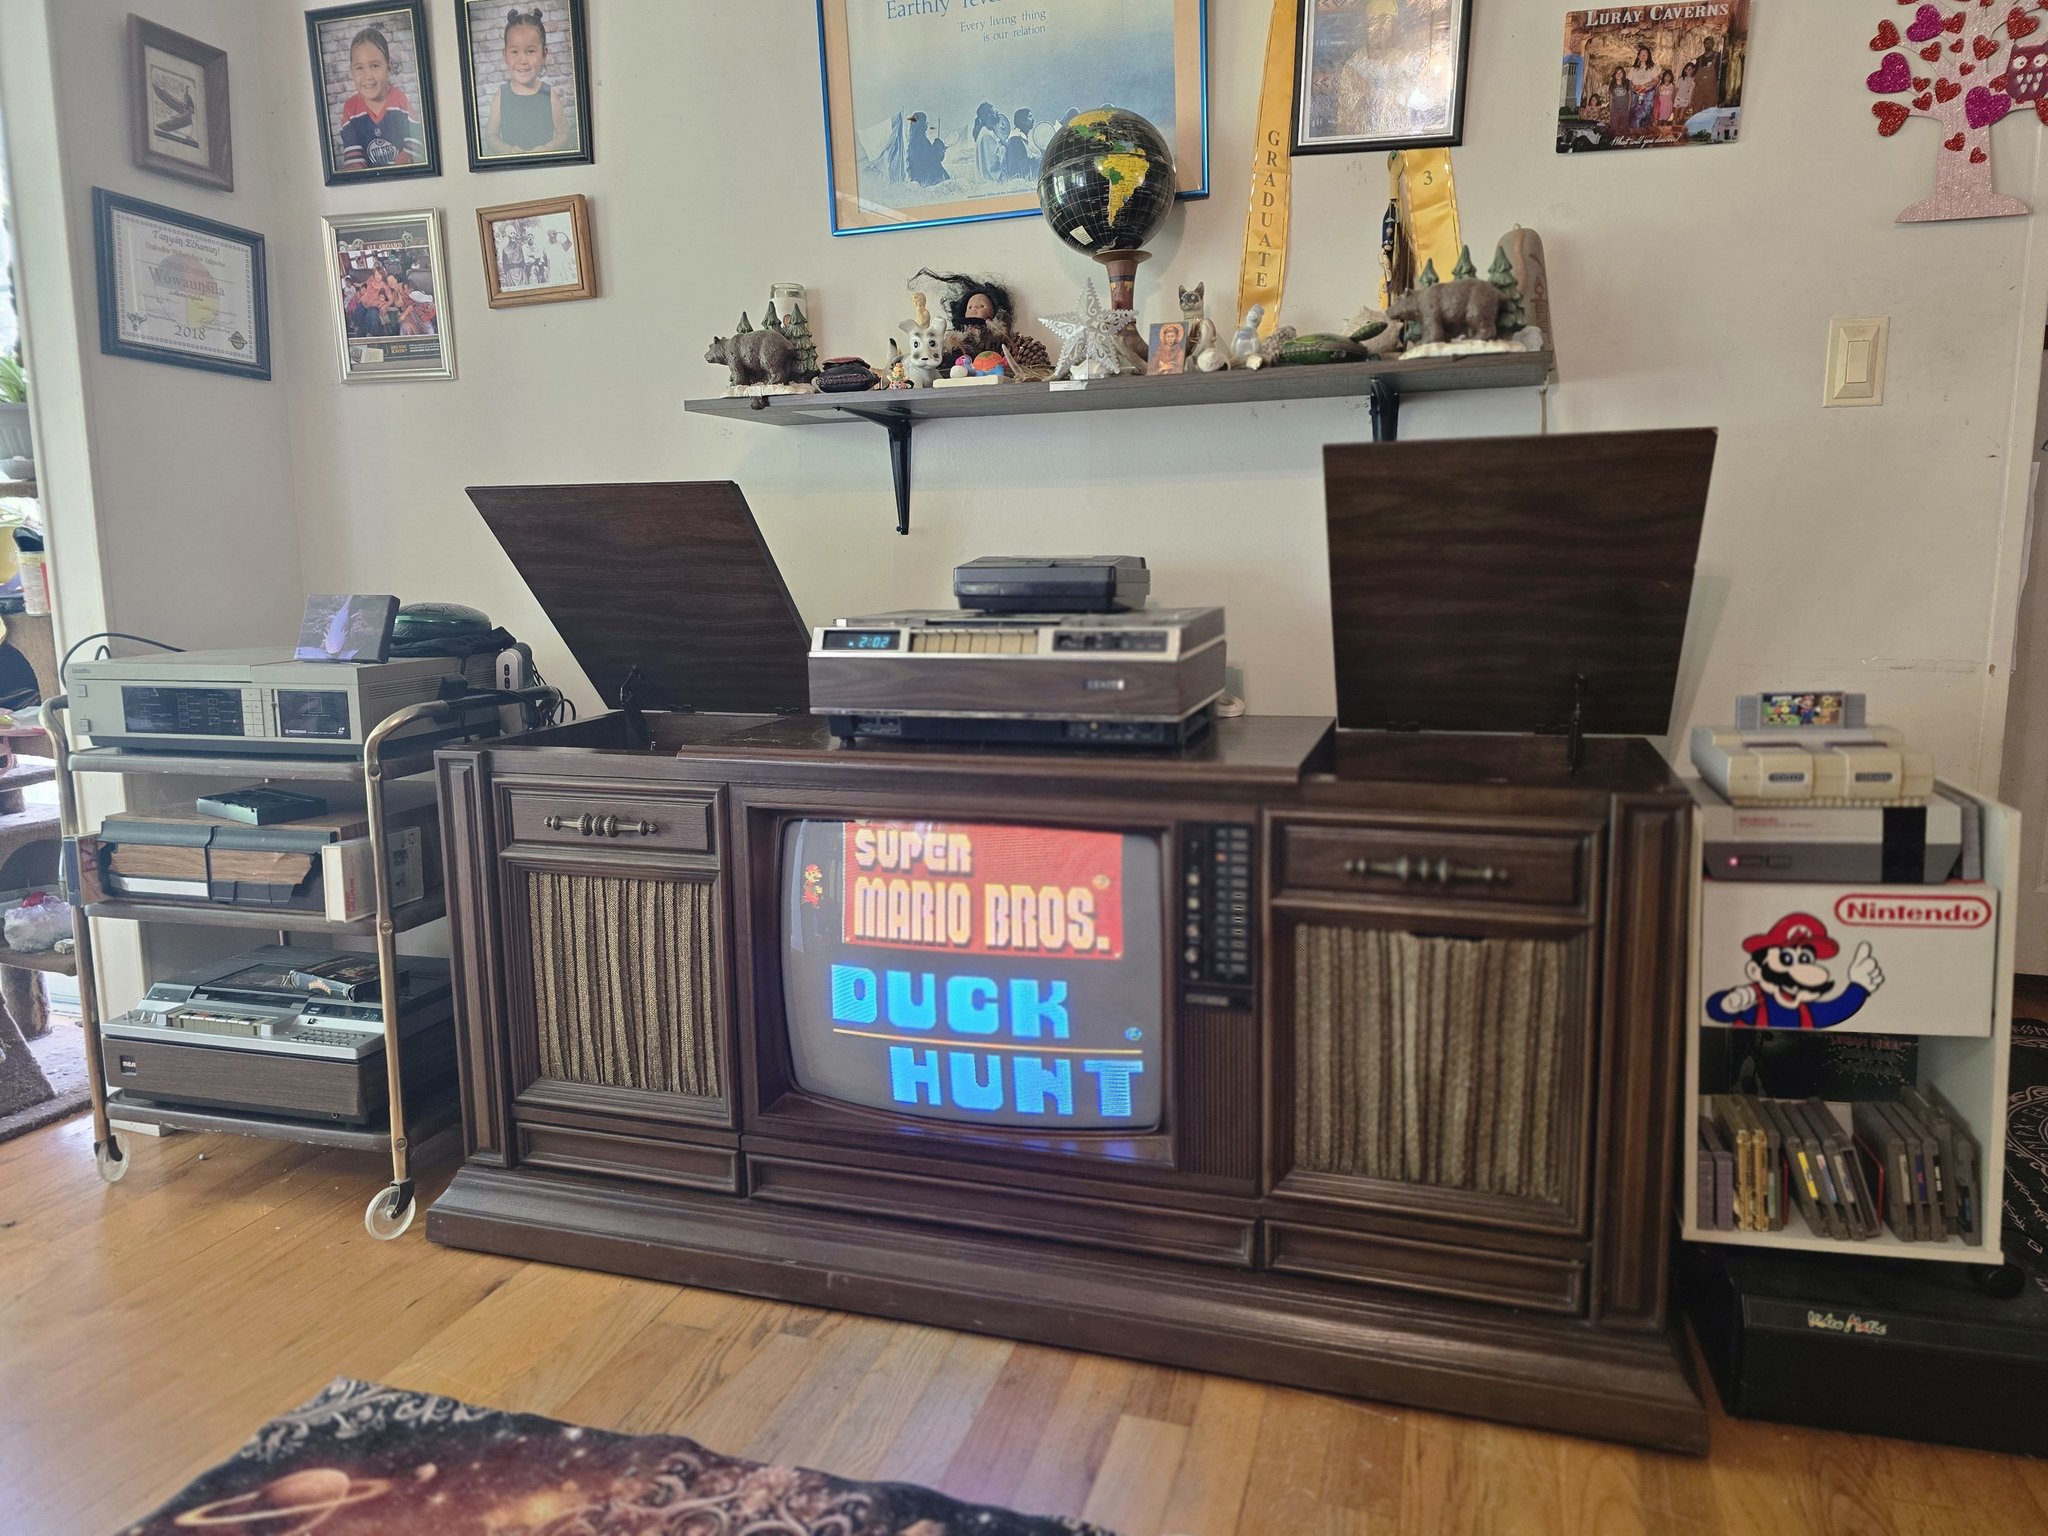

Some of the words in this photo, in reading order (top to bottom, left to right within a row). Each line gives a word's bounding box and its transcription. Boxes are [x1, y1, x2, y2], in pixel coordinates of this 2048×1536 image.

[887, 0, 950, 19] Earthly
[990, 15, 1017, 26] living
[1021, 9, 1046, 21] thing
[1586, 10, 1642, 27] LURAY
[1650, 3, 1729, 21] CAVERNS
[983, 32, 990, 42] is
[993, 30, 1009, 41] our
[1609, 135, 1633, 146] What
[1629, 135, 1645, 145] will
[1641, 138, 1654, 148] you
[1422, 170, 1434, 186] 3
[1255, 130, 1281, 288] GRADUATE
[174, 325, 206, 340] 2018
[858, 635, 891, 648] 2:02
[854, 827, 972, 873] SUPER
[853, 876, 972, 946] MARIO
[984, 883, 1111, 951] BROS.
[1847, 902, 1980, 921] Nintendo
[831, 964, 1070, 1039] DUCK
[889, 1046, 1144, 1117] HUNT
